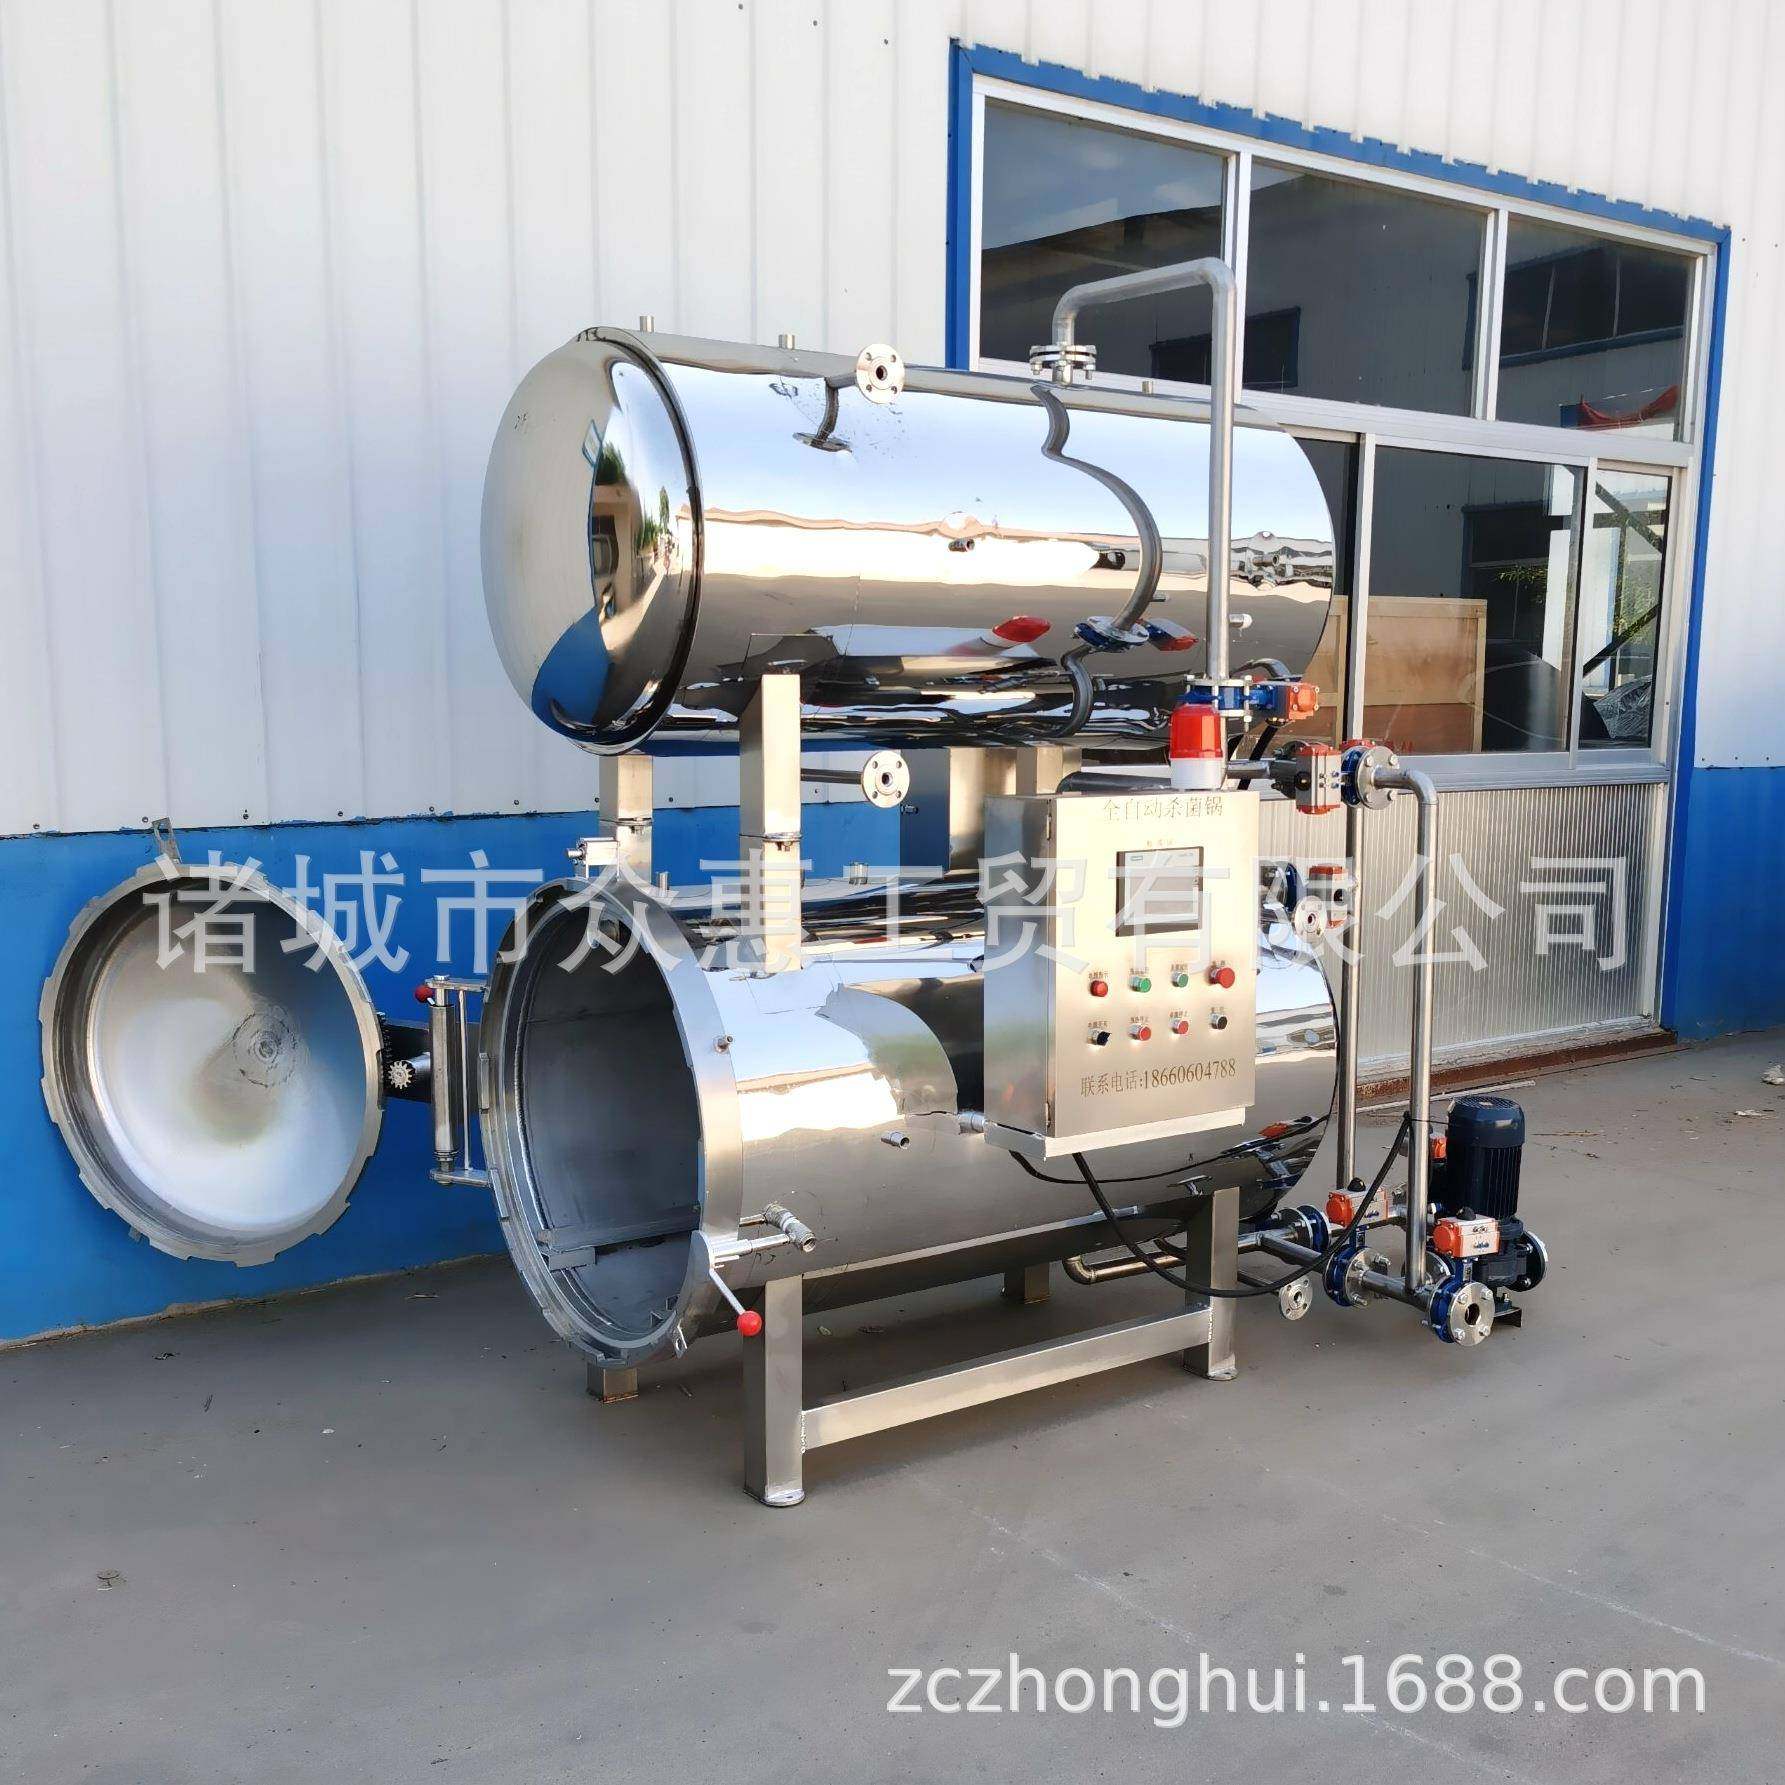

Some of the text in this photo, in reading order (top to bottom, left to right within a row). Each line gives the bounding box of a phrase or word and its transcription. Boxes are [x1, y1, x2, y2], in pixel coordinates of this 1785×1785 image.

[1104, 796, 1223, 821] 全自动杀菌锅
